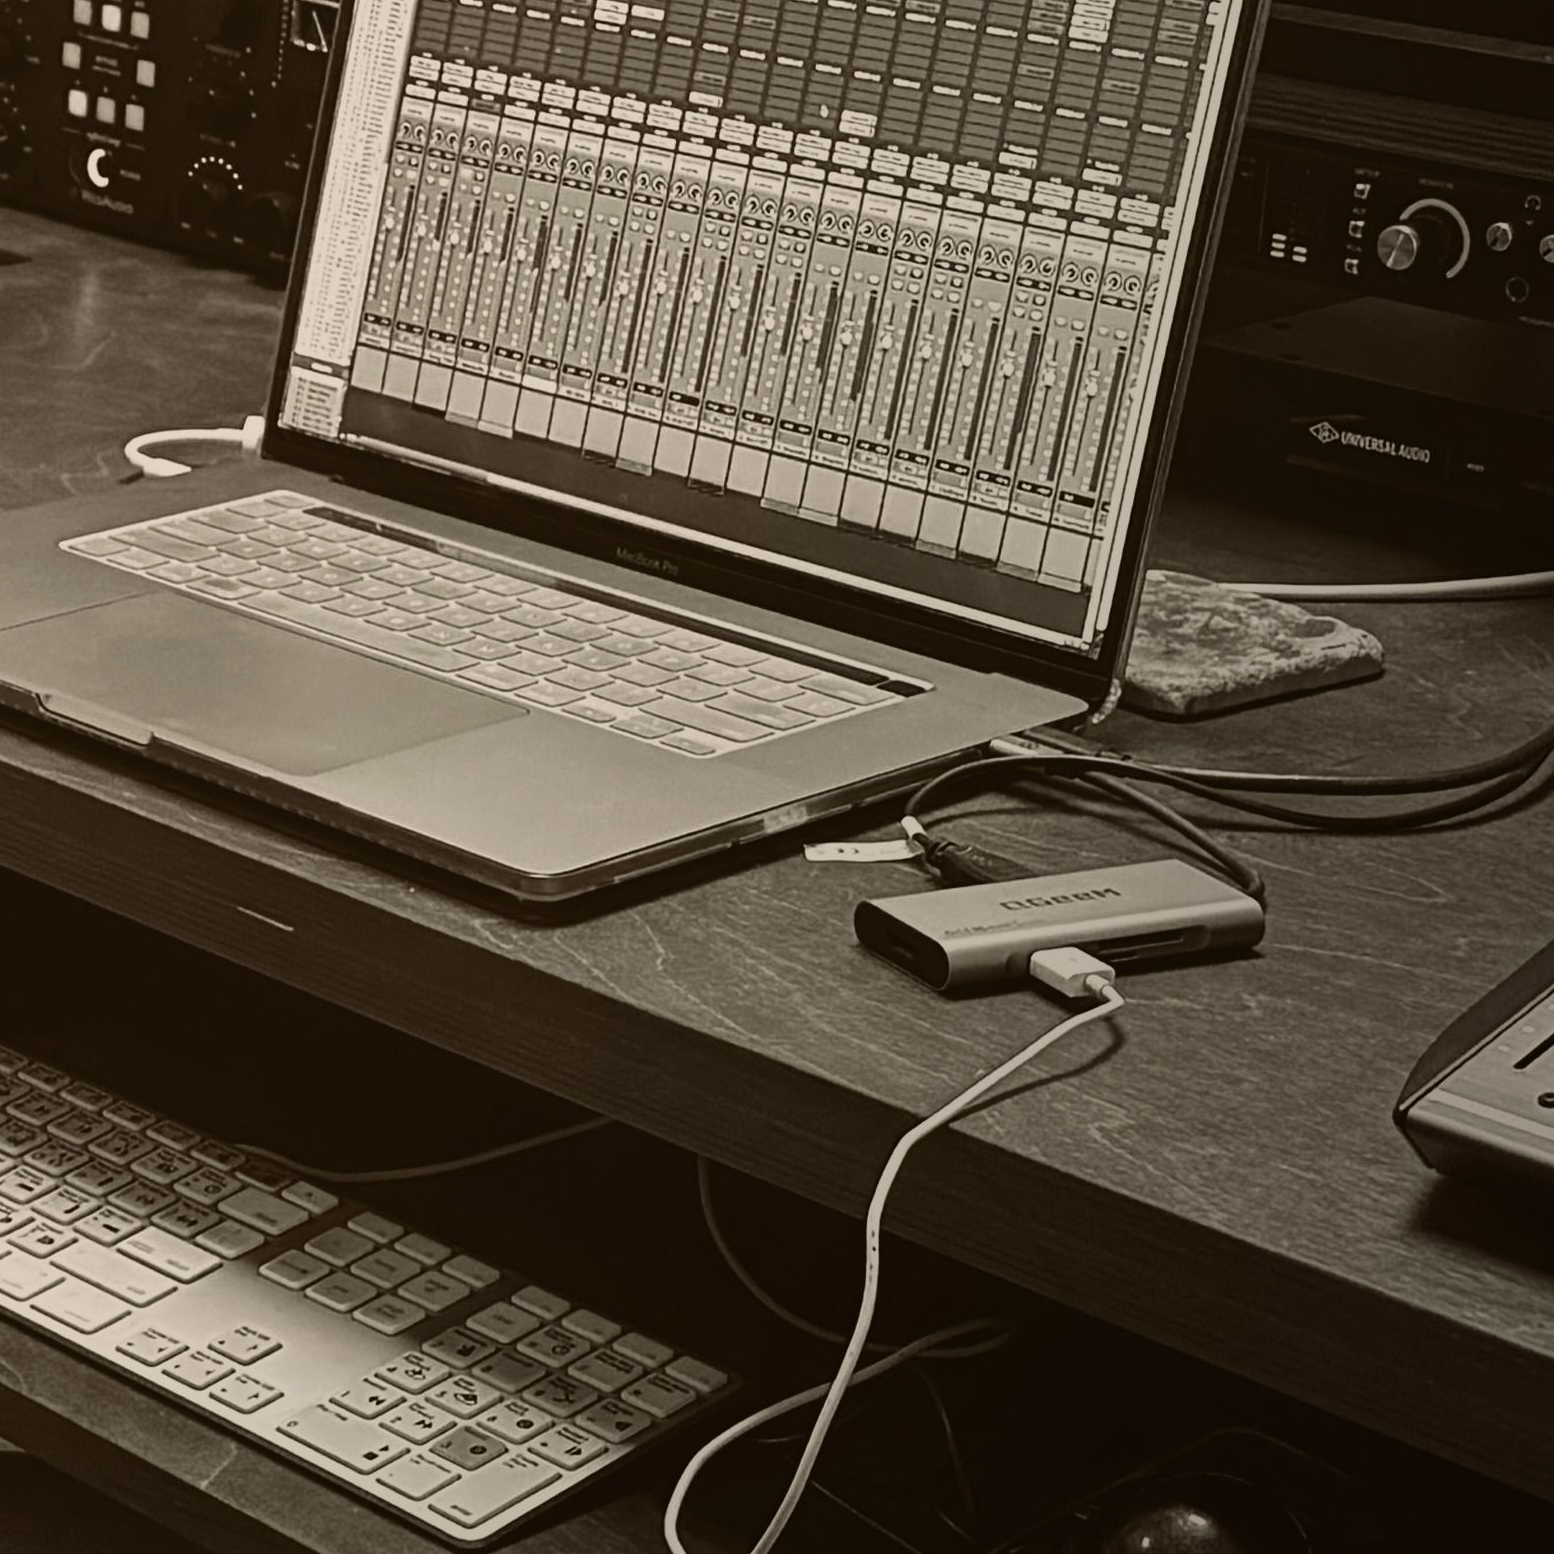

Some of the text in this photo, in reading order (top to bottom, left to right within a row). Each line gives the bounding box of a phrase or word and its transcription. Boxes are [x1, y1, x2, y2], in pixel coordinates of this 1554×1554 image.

[1341, 431, 1396, 456] UNIVERSAL
[1397, 444, 1431, 464] AUDIO
[616, 546, 660, 571] MacBook
